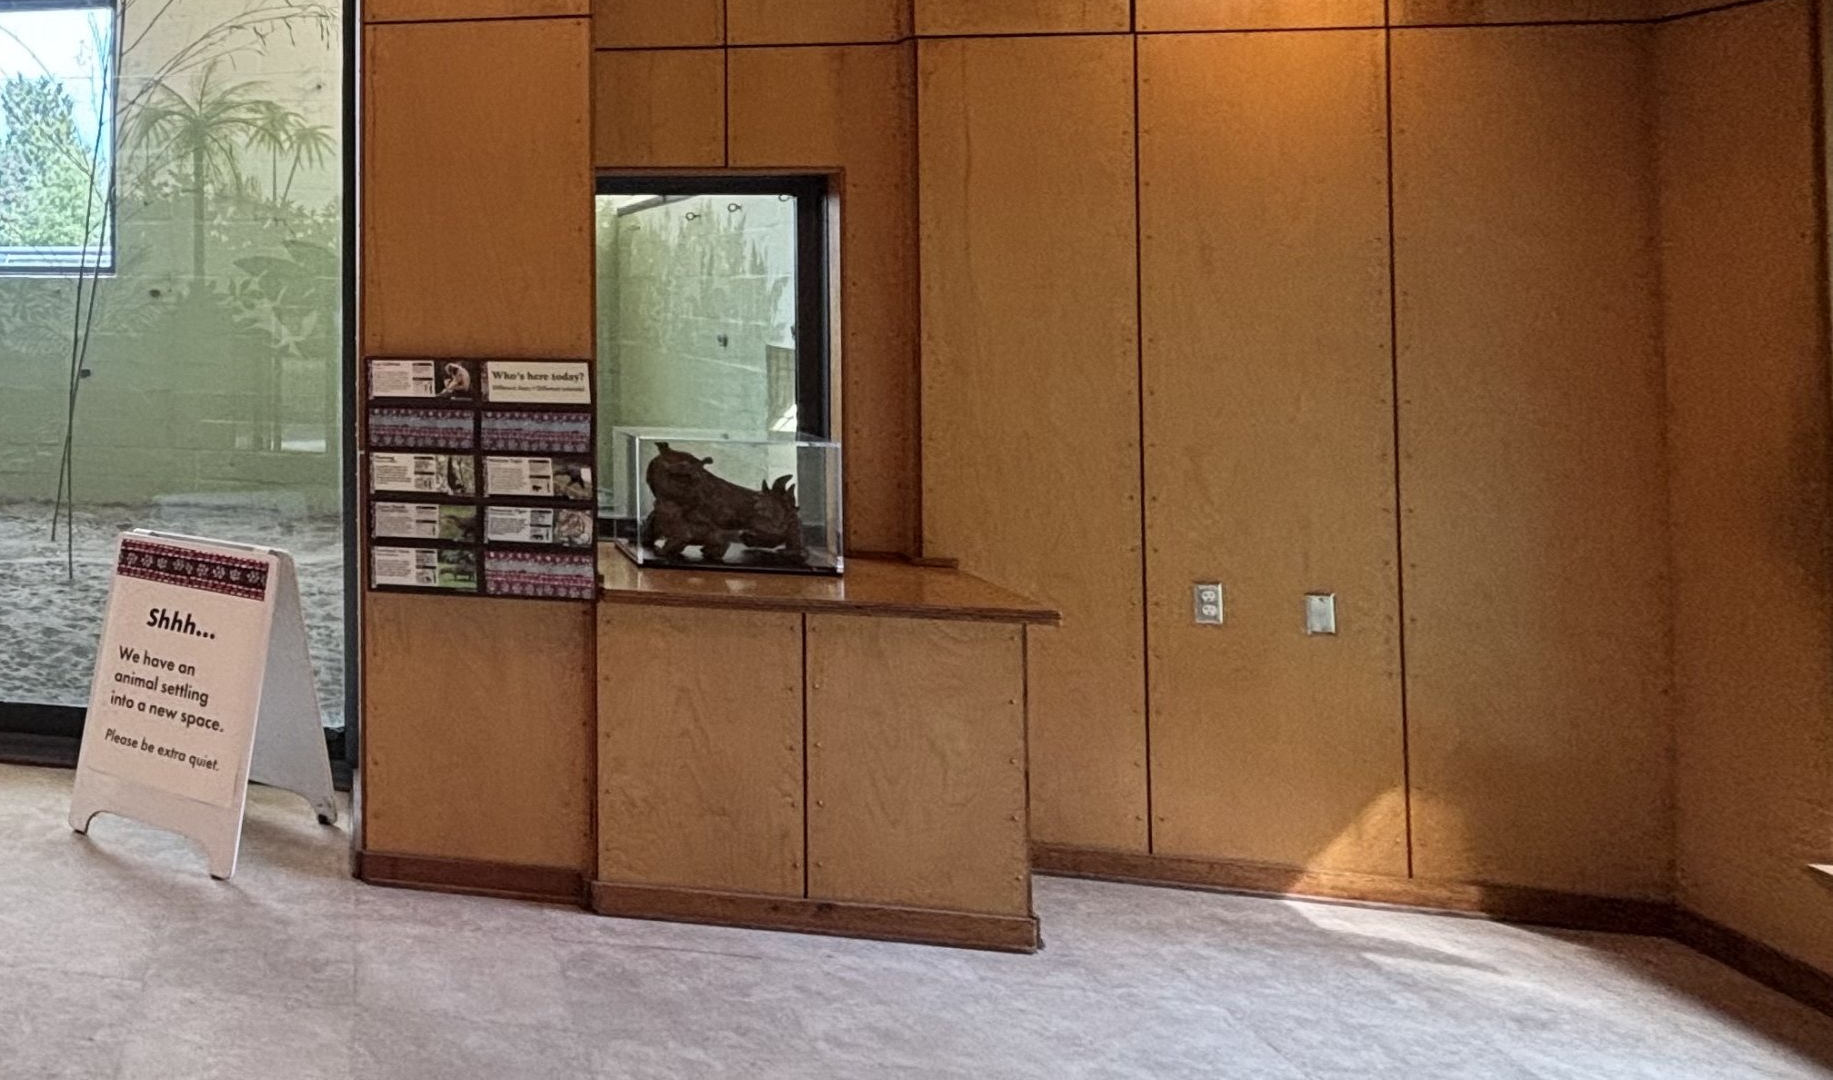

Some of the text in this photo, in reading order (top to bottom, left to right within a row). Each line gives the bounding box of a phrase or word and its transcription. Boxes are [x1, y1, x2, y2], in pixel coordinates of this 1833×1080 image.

[492, 371, 584, 383] Who's here today?
[146, 608, 215, 639] Shhh...
[119, 644, 195, 676] We have an
[114, 671, 209, 707] animal settling
[110, 690, 224, 732] into a new space.
[105, 728, 220, 771] Please be extra quiet.
